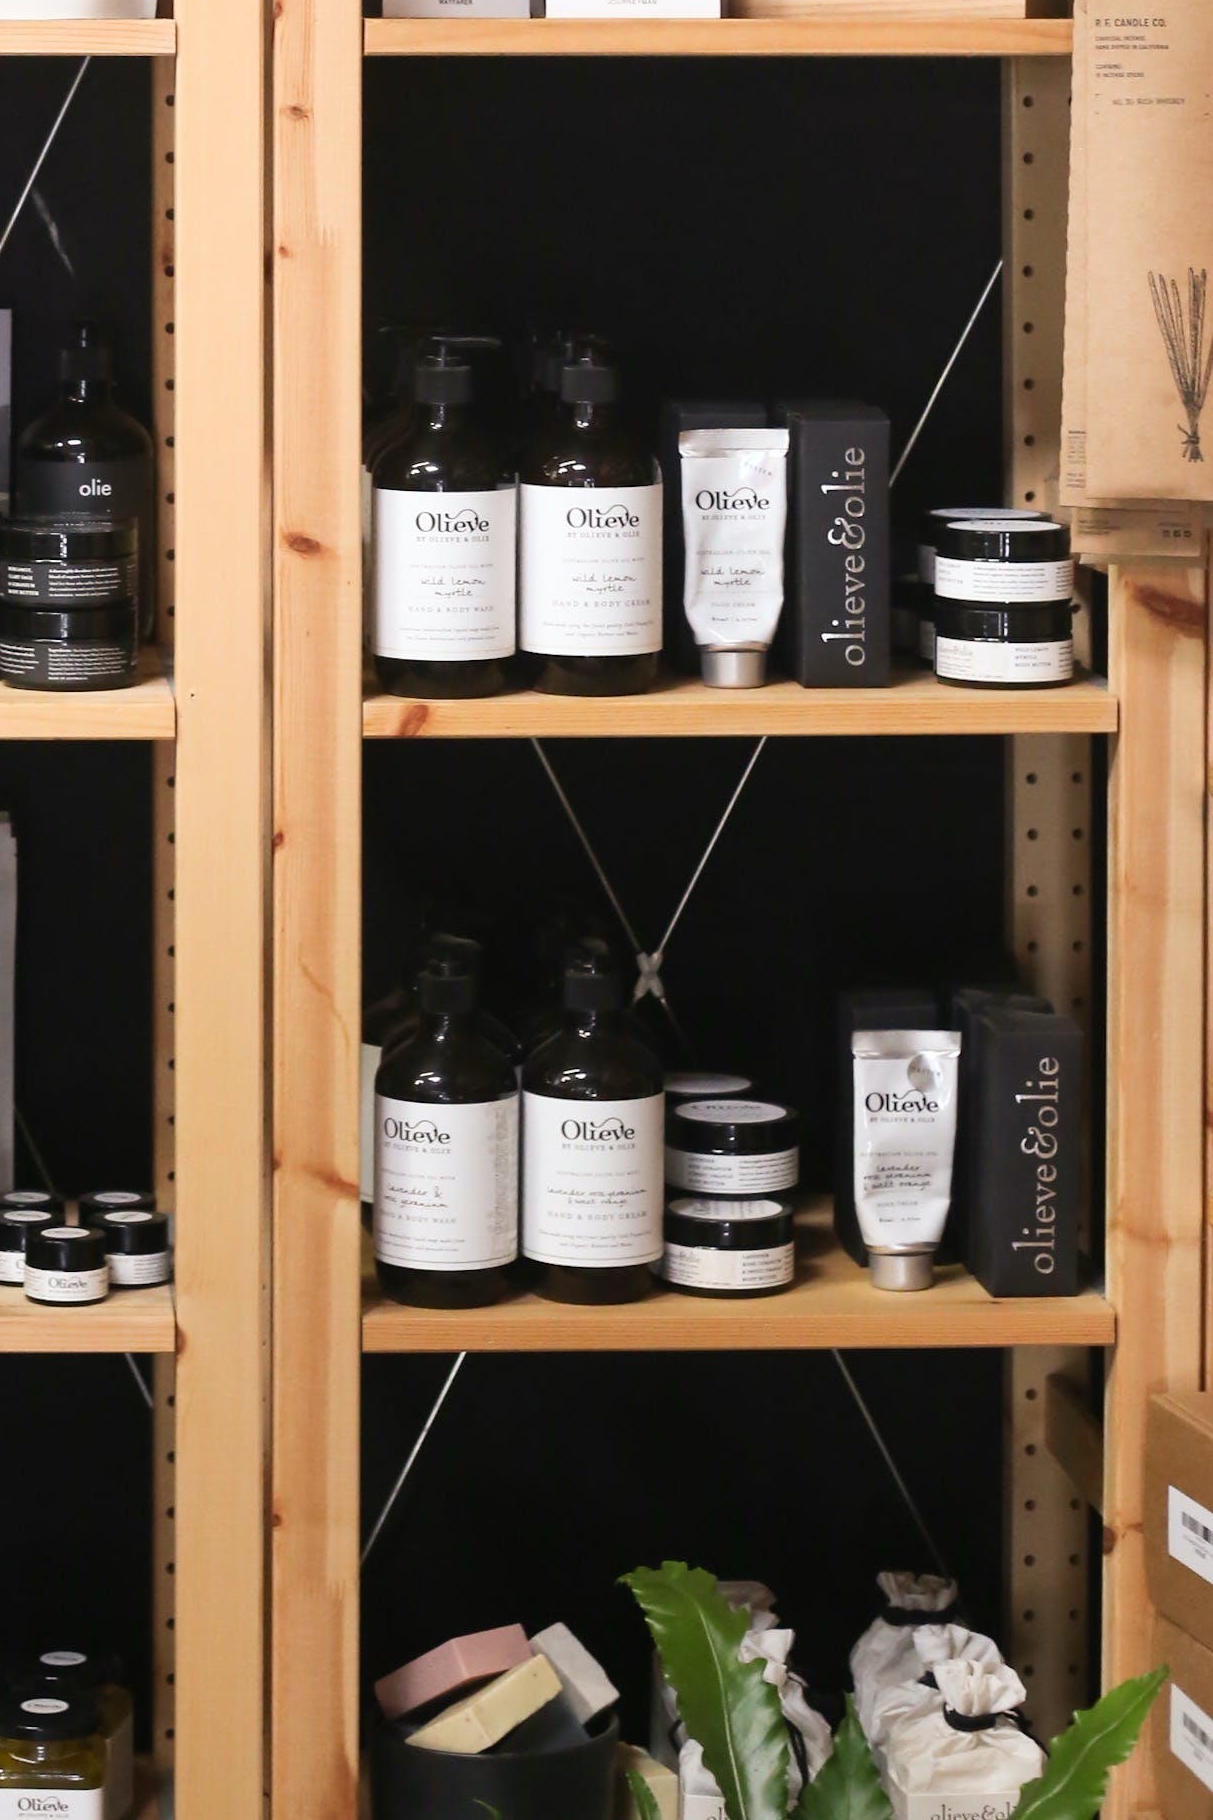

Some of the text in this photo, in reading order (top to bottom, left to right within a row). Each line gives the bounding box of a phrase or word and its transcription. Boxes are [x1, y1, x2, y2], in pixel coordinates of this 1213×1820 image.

[1114, 18, 1149, 27] CANDLE
[79, 478, 113, 497] olie
[695, 487, 770, 510] Olieve
[416, 508, 490, 533] Olieve
[567, 504, 640, 528] Olieve
[821, 447, 866, 667] olieve&olie
[865, 1089, 938, 1113] Olieve
[384, 1117, 451, 1144] Olieve
[561, 1117, 635, 1141] Olieve
[1011, 1055, 1060, 1274] olieve&olie
[18, 1795, 69, 1812] Olieve
